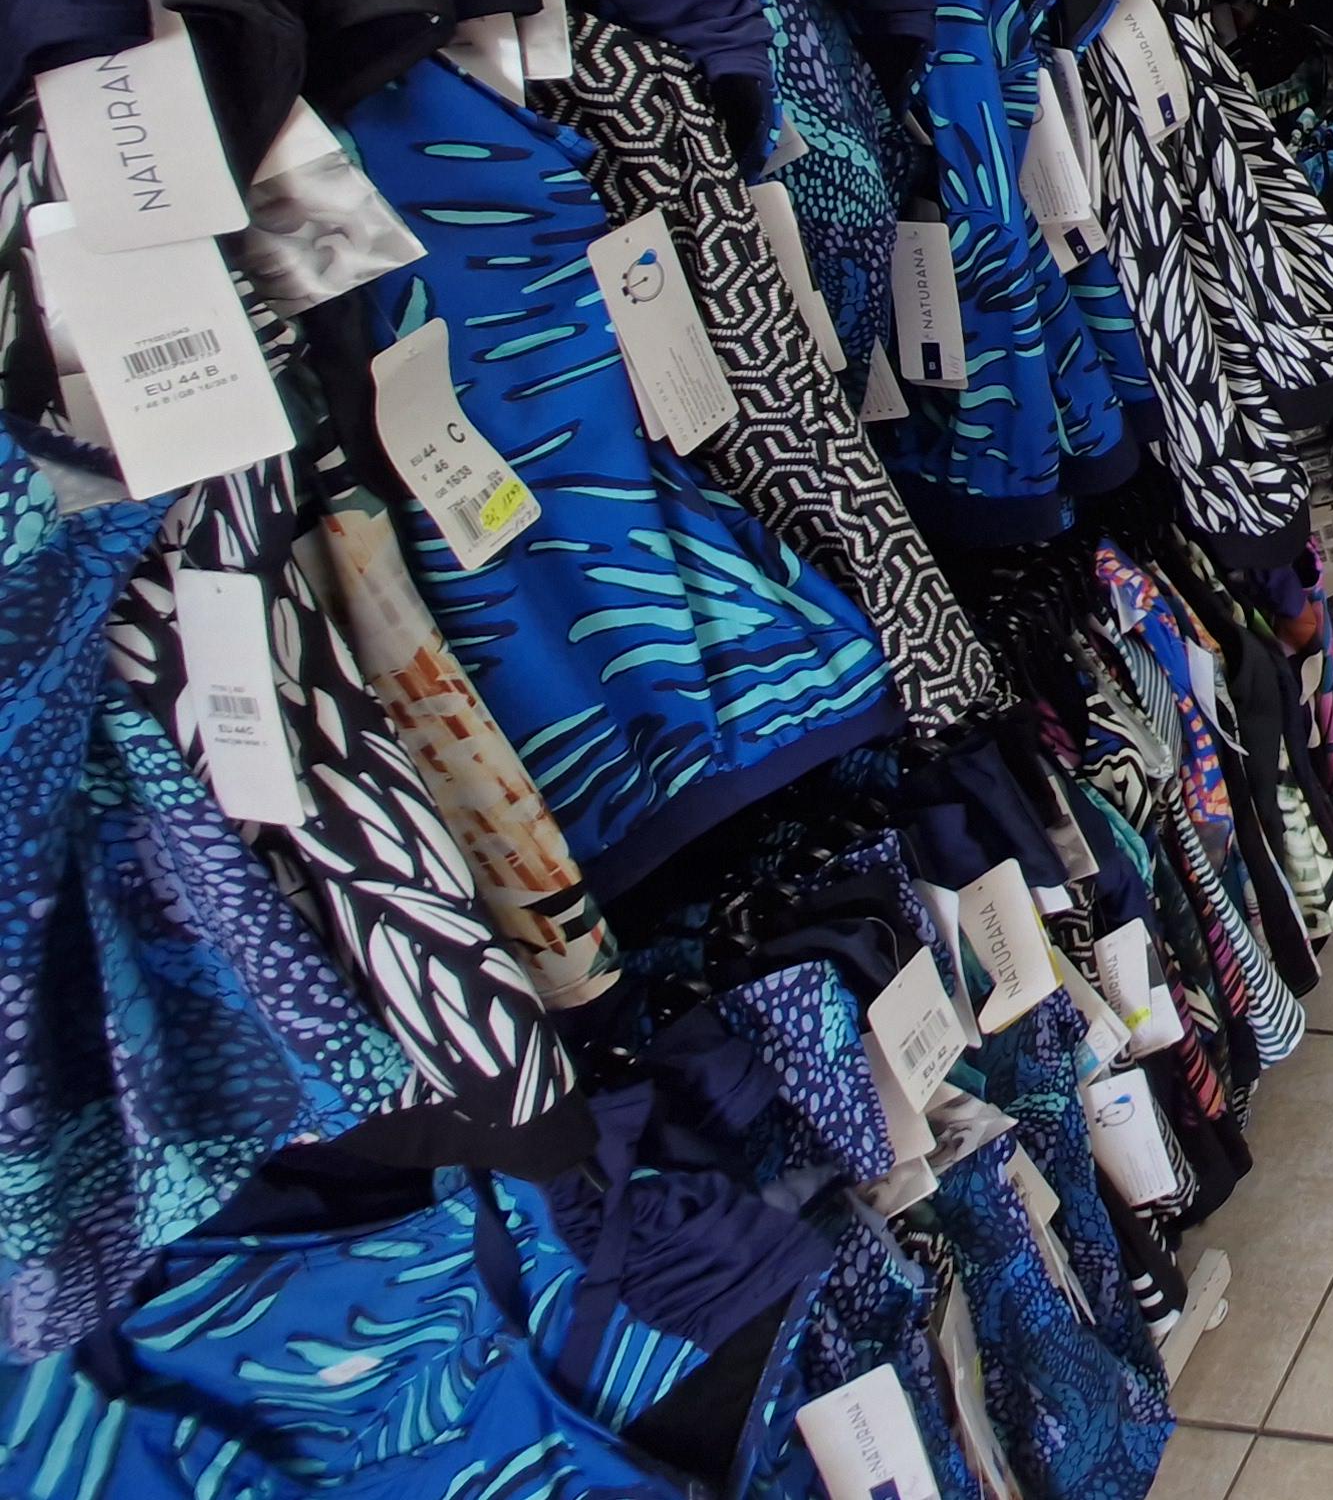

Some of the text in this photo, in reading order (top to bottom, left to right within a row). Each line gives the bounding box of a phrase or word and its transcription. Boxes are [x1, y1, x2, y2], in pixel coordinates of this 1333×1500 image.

[1123, 12, 1166, 87] NATURANA
[913, 246, 934, 331] NATURANA
[144, 364, 220, 397] EU 44 B
[422, 443, 438, 459] 44
[447, 422, 466, 444] C
[434, 458, 450, 475] 46
[978, 901, 1023, 999] NATURANA
[846, 1401, 882, 1473] NATURANA
